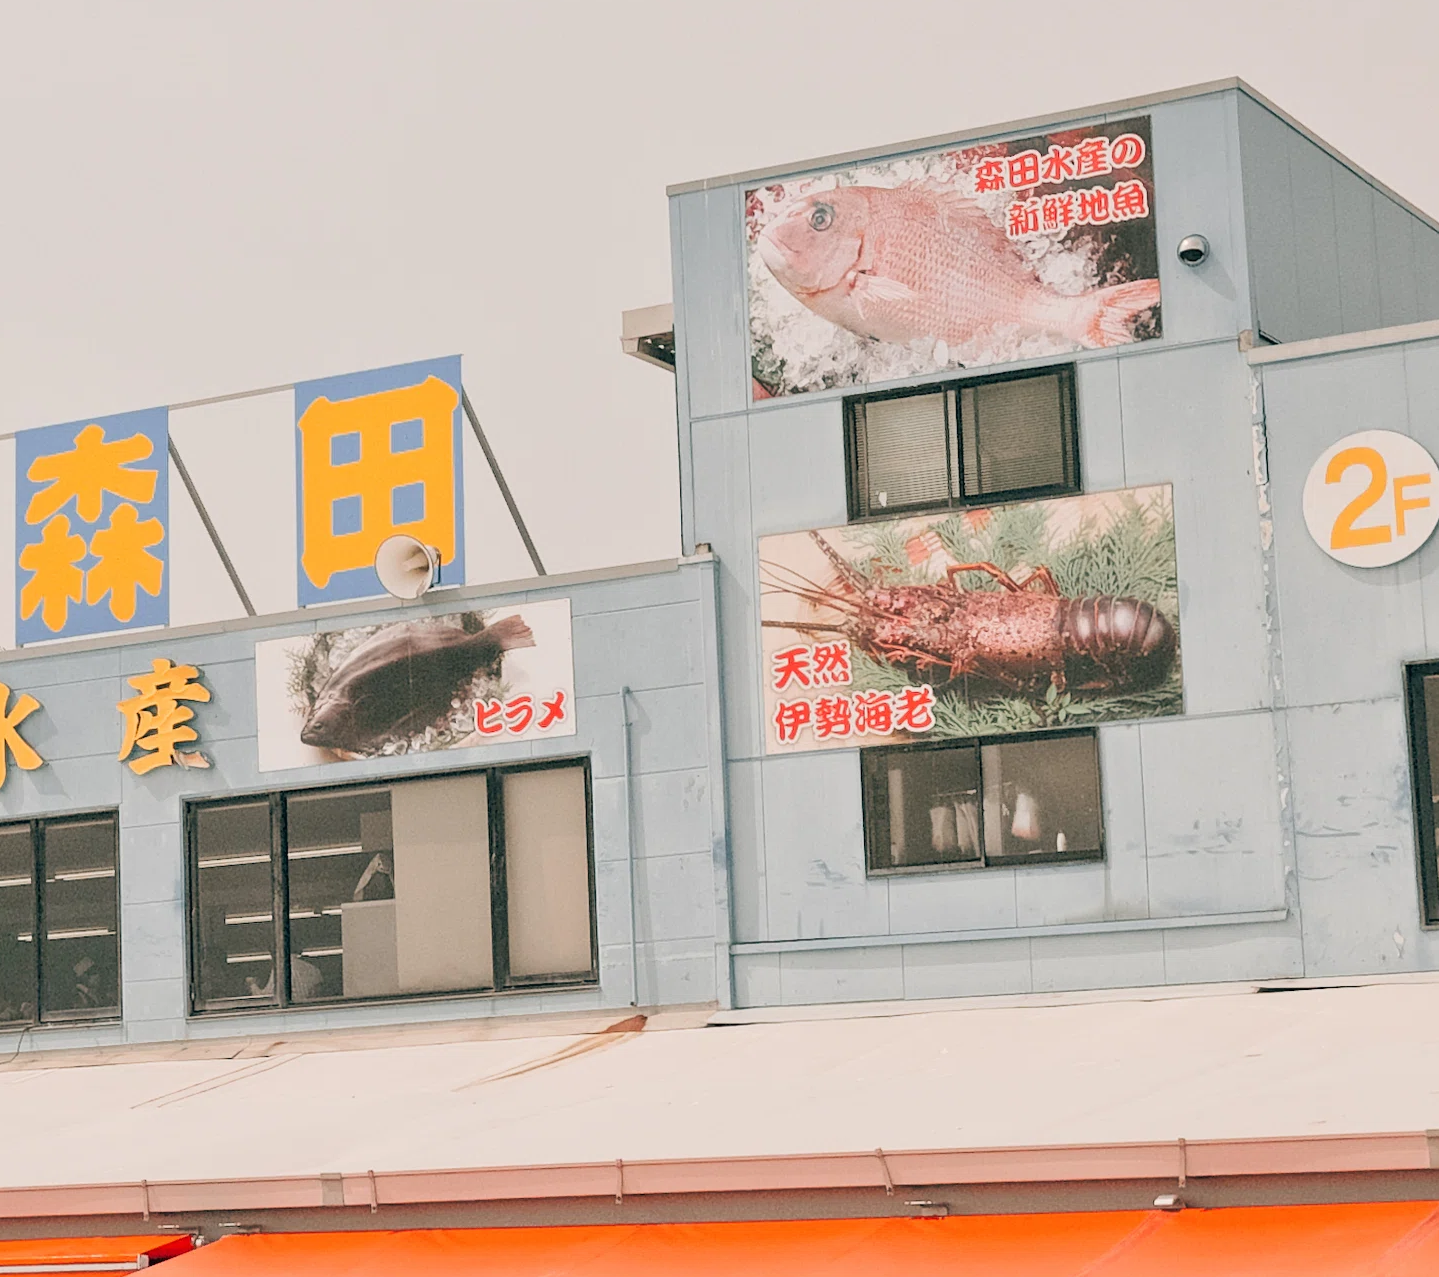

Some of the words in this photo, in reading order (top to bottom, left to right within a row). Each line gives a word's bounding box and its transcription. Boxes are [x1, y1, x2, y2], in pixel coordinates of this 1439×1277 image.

[972, 132, 1145, 193] 森田水産の
[1007, 184, 1150, 237] 新鮮地魚
[1324, 445, 1432, 551] 2F
[773, 641, 853, 690] 天然
[473, 688, 570, 739] ヒラメ
[774, 684, 937, 743] 伊勢海老
